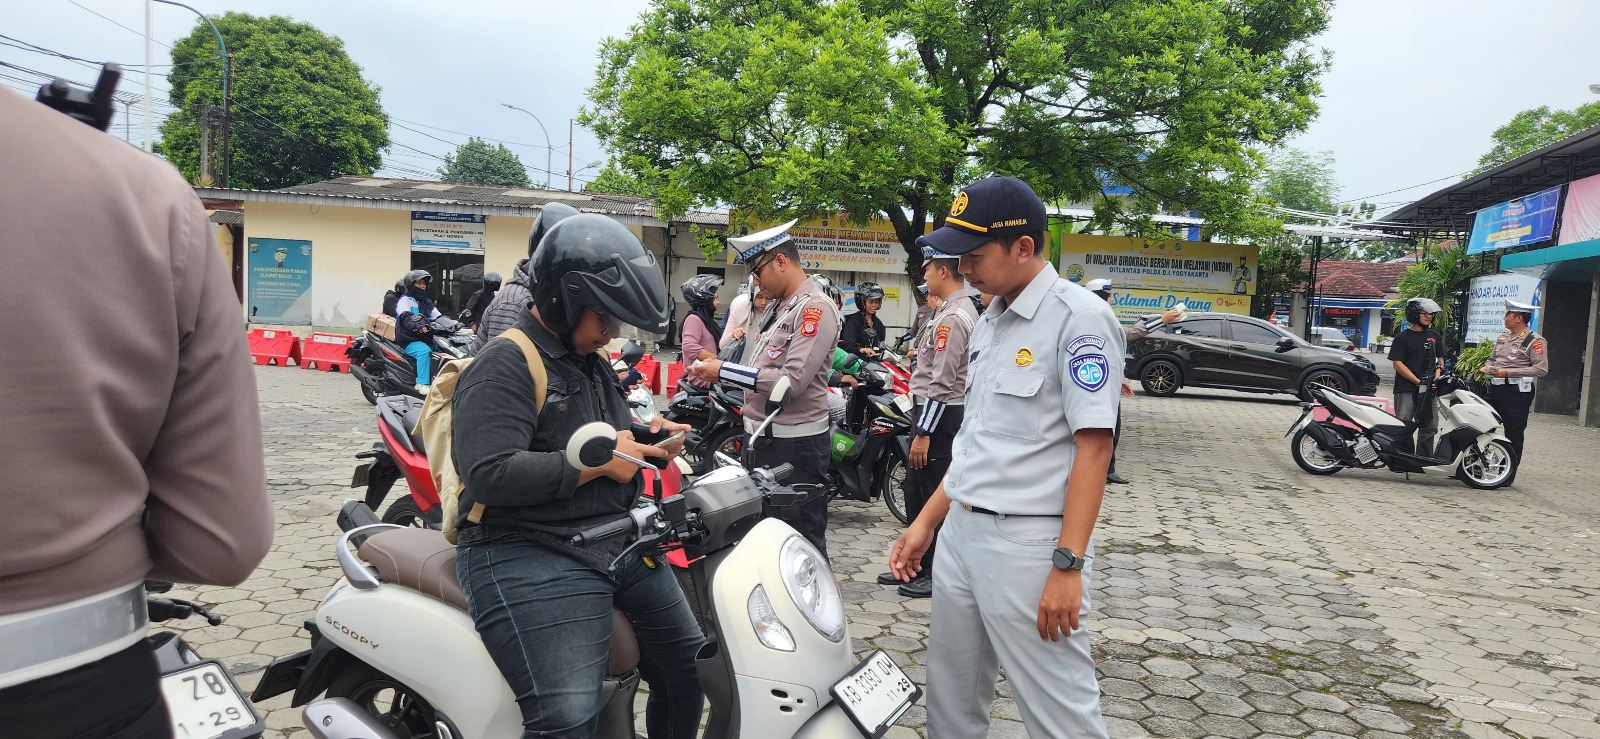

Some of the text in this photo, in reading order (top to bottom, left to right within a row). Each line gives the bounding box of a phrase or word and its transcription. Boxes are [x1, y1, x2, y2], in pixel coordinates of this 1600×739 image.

[1004, 218, 1028, 227] RAHARJA
[812, 228, 837, 239] WAJIB
[839, 230, 876, 240] MEMAKAI
[829, 254, 858, 263] CEGAH
[859, 256, 898, 265] COVID-19
[1086, 254, 1092, 264] DI
[1093, 254, 1118, 265] WILAYAH
[1112, 292, 1163, 308] Selamat
[326, 616, 379, 649] SCOOPY
[842, 686, 861, 707] AB
[855, 668, 882, 694] 3393
